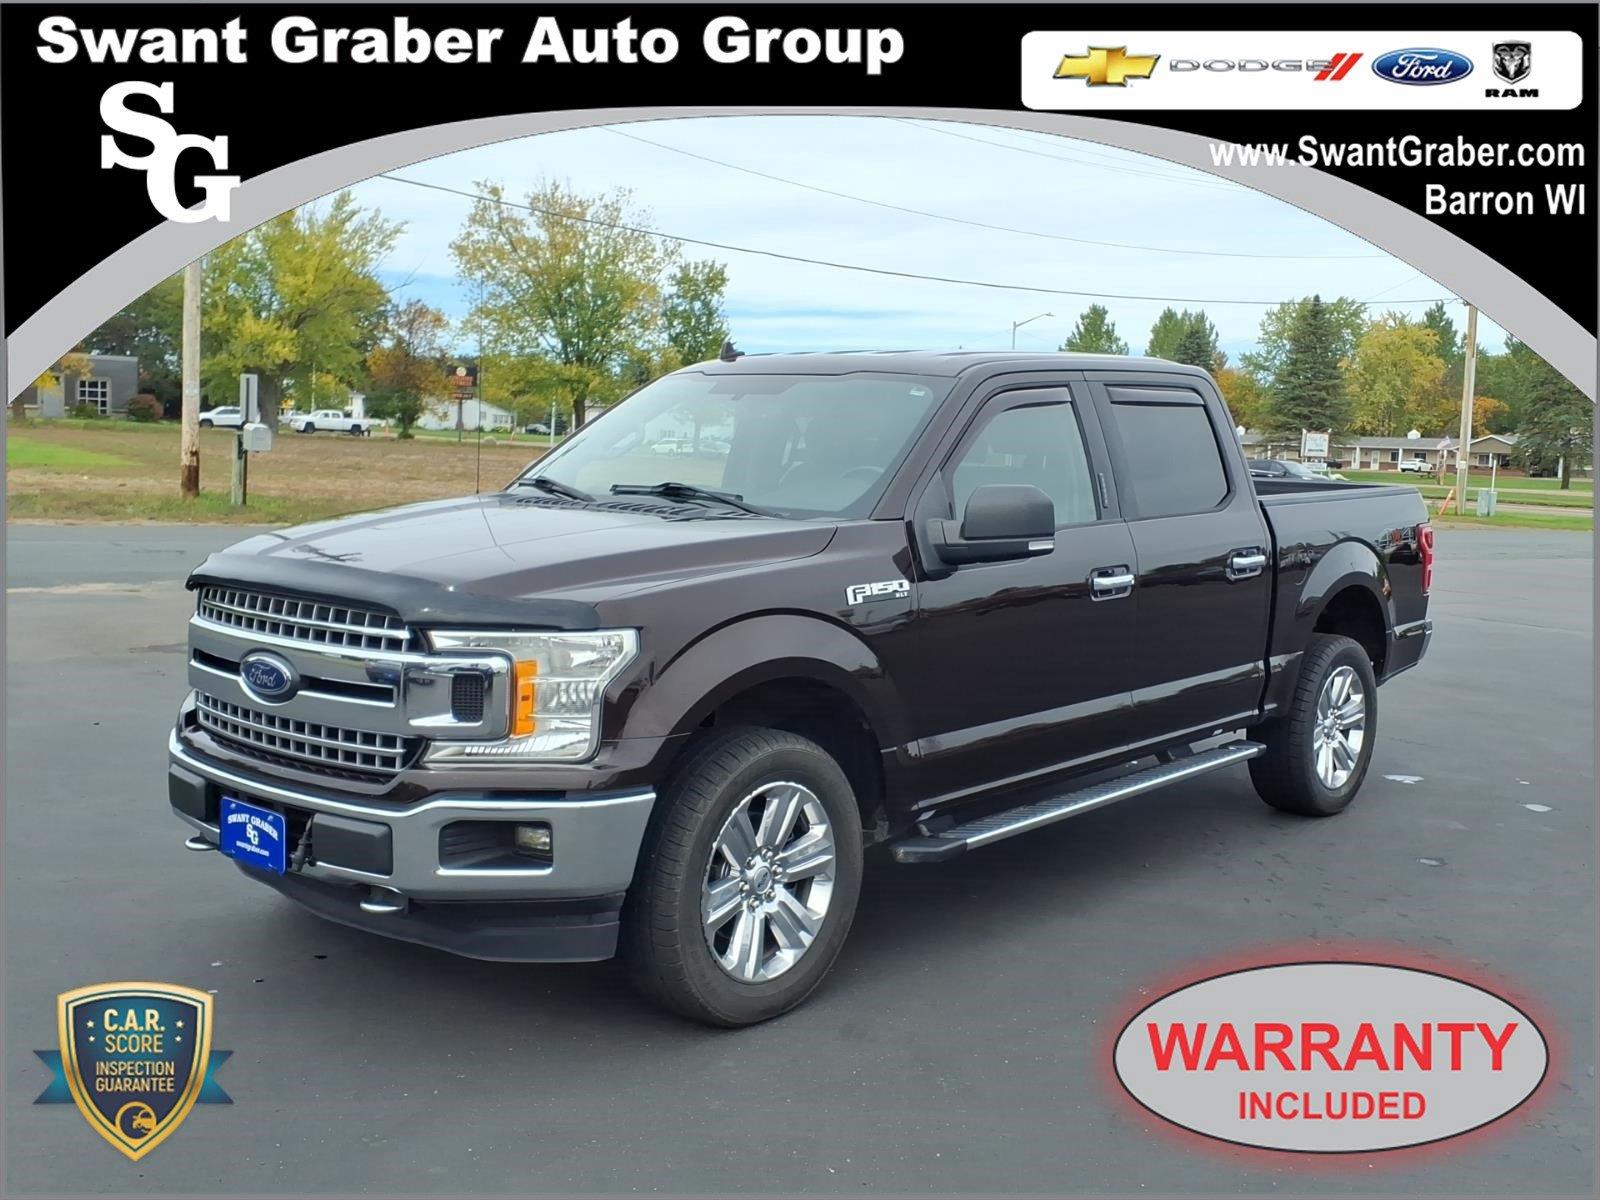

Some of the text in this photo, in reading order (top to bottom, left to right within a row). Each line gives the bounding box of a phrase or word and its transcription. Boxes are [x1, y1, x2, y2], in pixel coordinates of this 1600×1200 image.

[249, 663, 277, 687] Ford
[227, 813, 279, 841] SWANT GRABER
